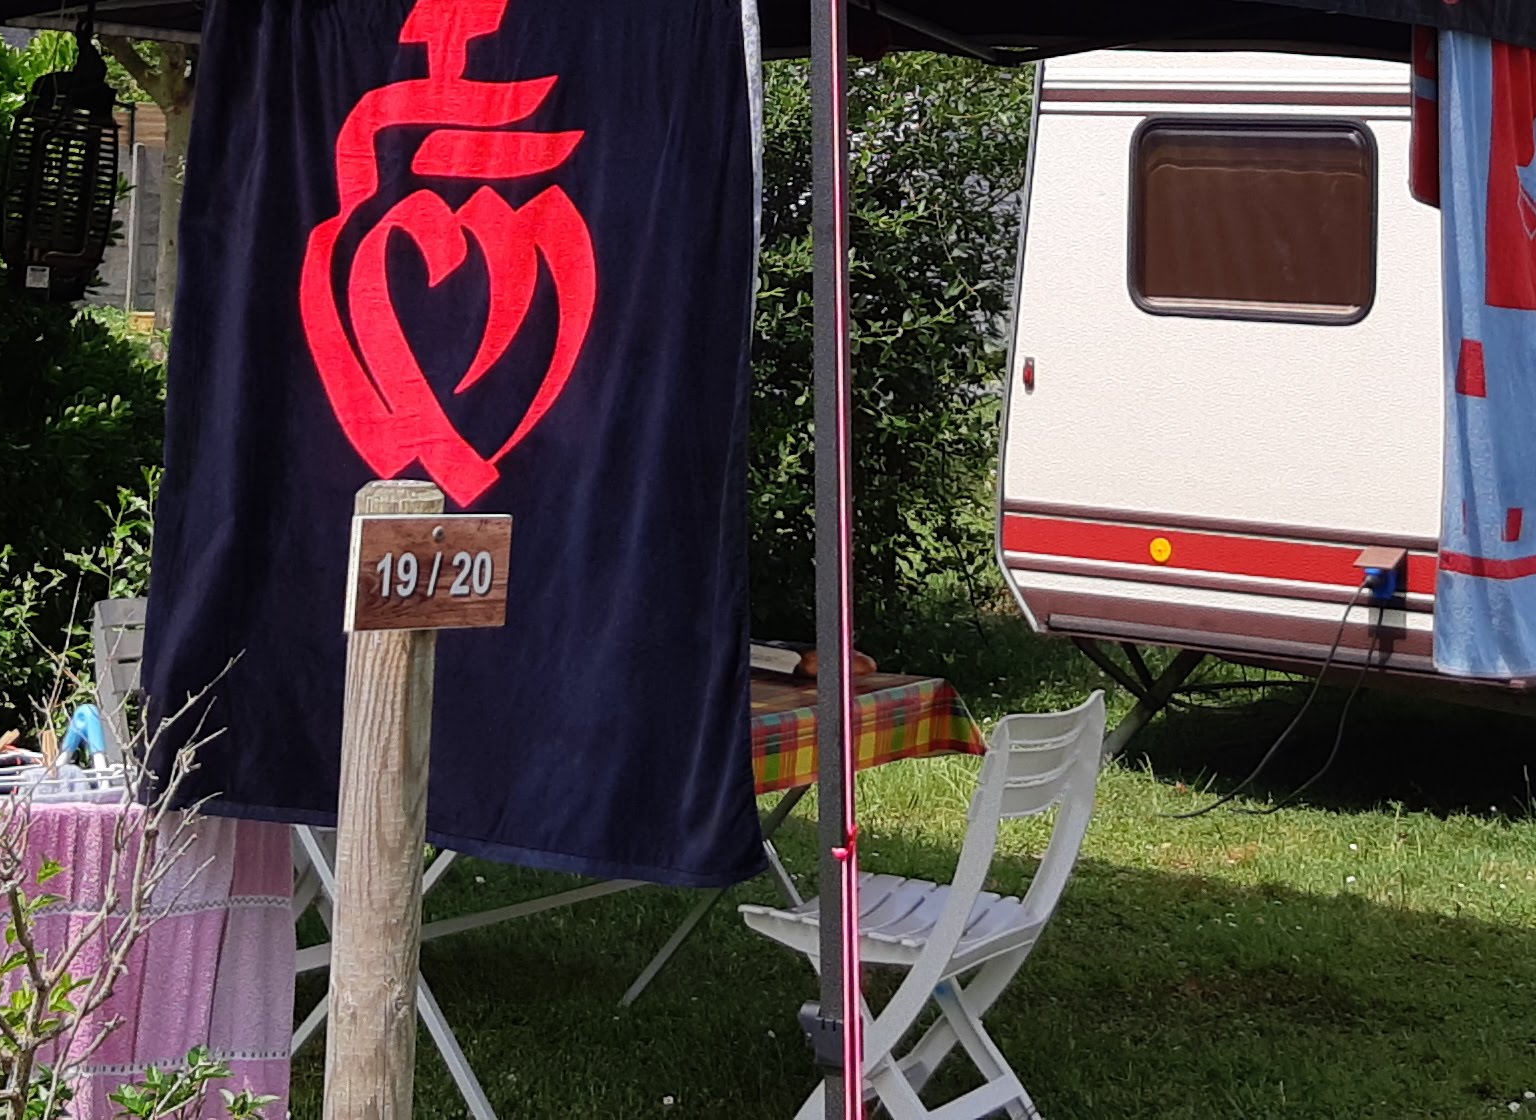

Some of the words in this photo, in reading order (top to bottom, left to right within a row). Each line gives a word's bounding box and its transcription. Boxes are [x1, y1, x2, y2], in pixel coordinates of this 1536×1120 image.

[375, 550, 419, 599] 19
[427, 551, 443, 599] /
[449, 550, 494, 597] 20
